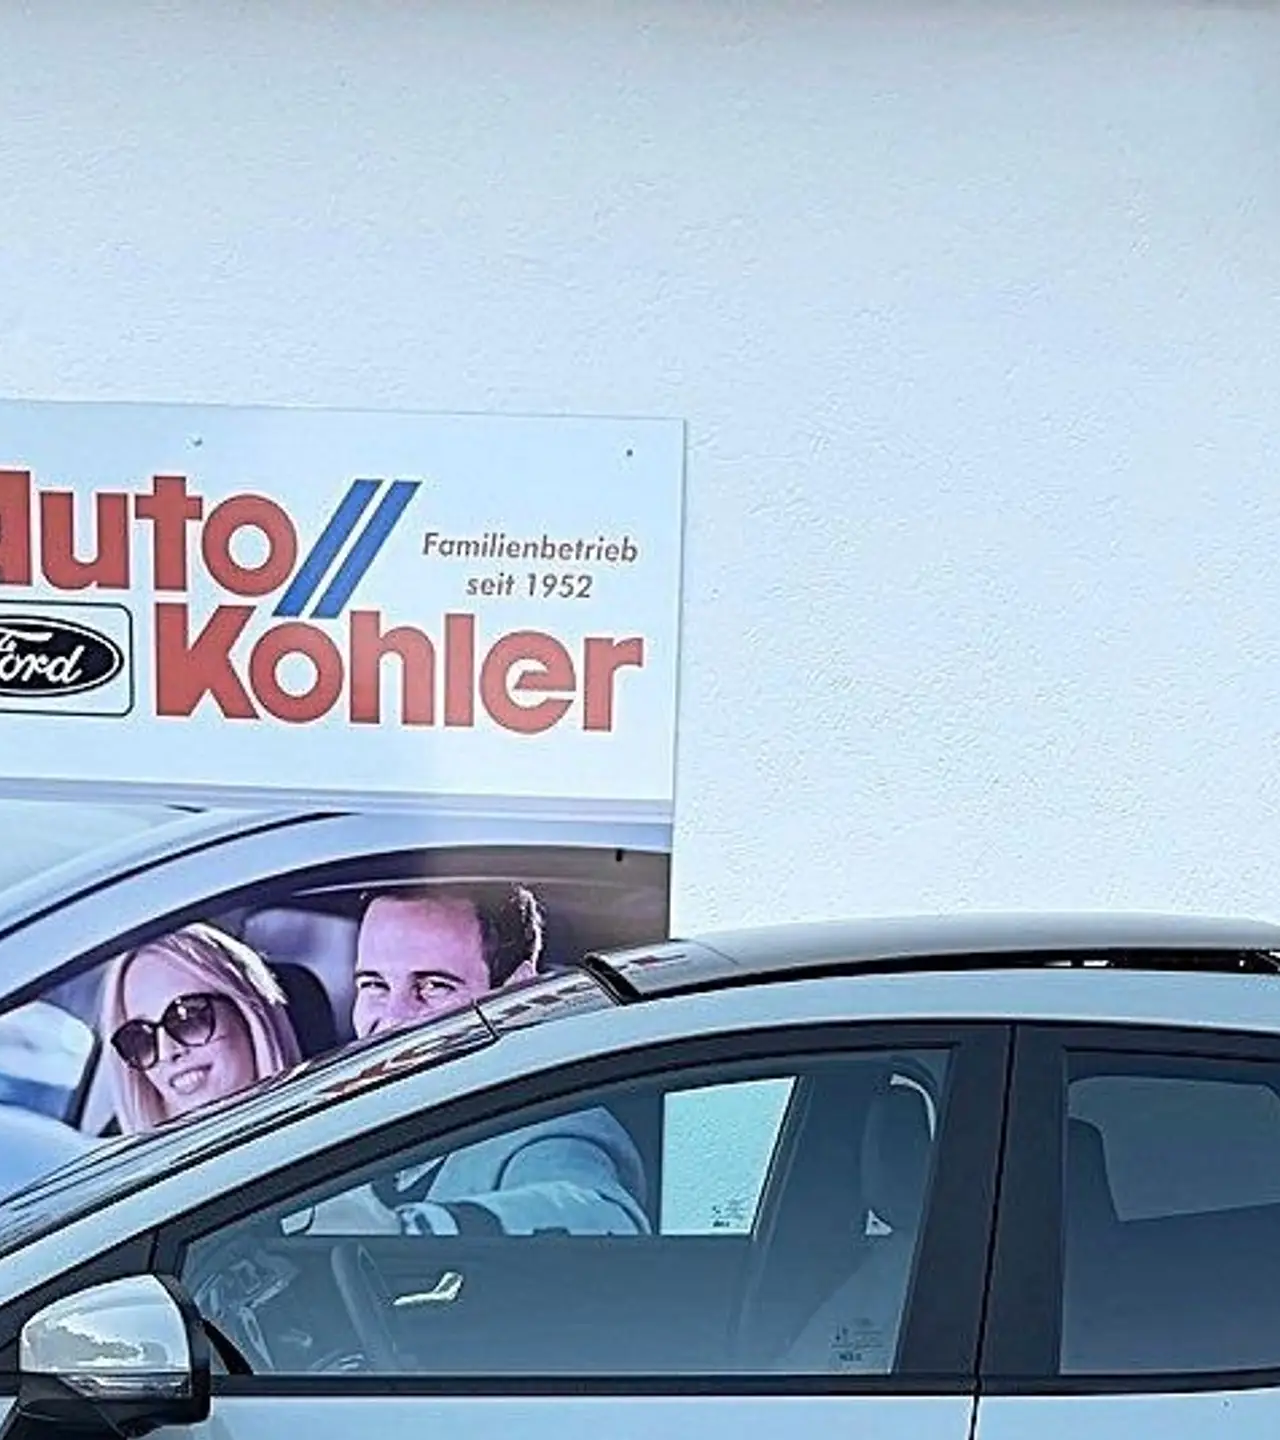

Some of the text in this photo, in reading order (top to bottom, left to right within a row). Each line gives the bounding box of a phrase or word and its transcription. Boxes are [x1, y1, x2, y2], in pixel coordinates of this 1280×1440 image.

[423, 533, 637, 562] Familienbetrieb
[467, 572, 592, 598] seit 1952
